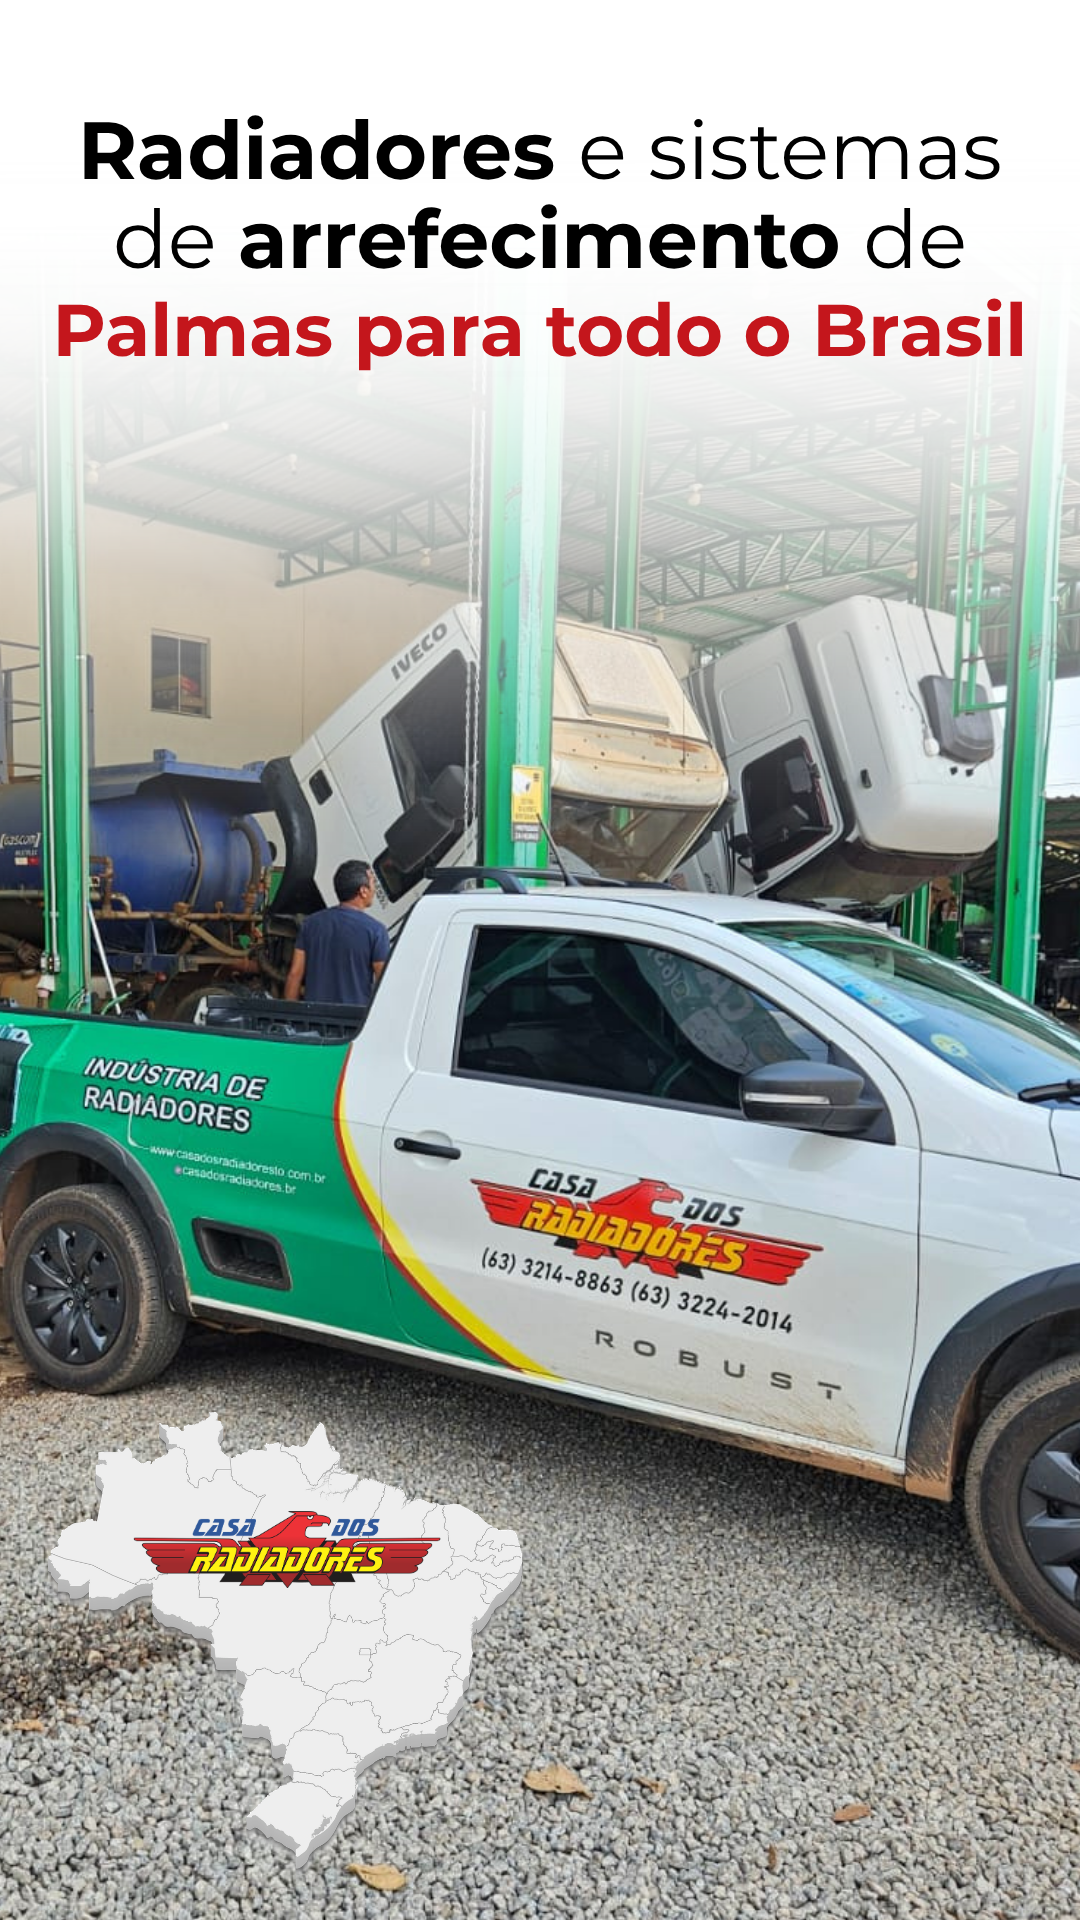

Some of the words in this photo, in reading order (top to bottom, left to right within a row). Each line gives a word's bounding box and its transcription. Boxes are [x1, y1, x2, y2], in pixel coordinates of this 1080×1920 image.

[391, 623, 447, 680] IVECO
[84, 1057, 220, 1095] INDÚSTRIA
[225, 1075, 267, 1100] DE
[84, 1085, 251, 1133] RADIADORES
[528, 1168, 598, 1199] CASA
[682, 1198, 745, 1228] DOS
[521, 1200, 748, 1274] RADIADORES
[481, 1248, 516, 1275] (63)
[521, 1258, 624, 1296] 3214-8863
[631, 1281, 670, 1309] (63)
[677, 1292, 793, 1333] 3224-2014
[595, 1330, 841, 1400] ROBUST
